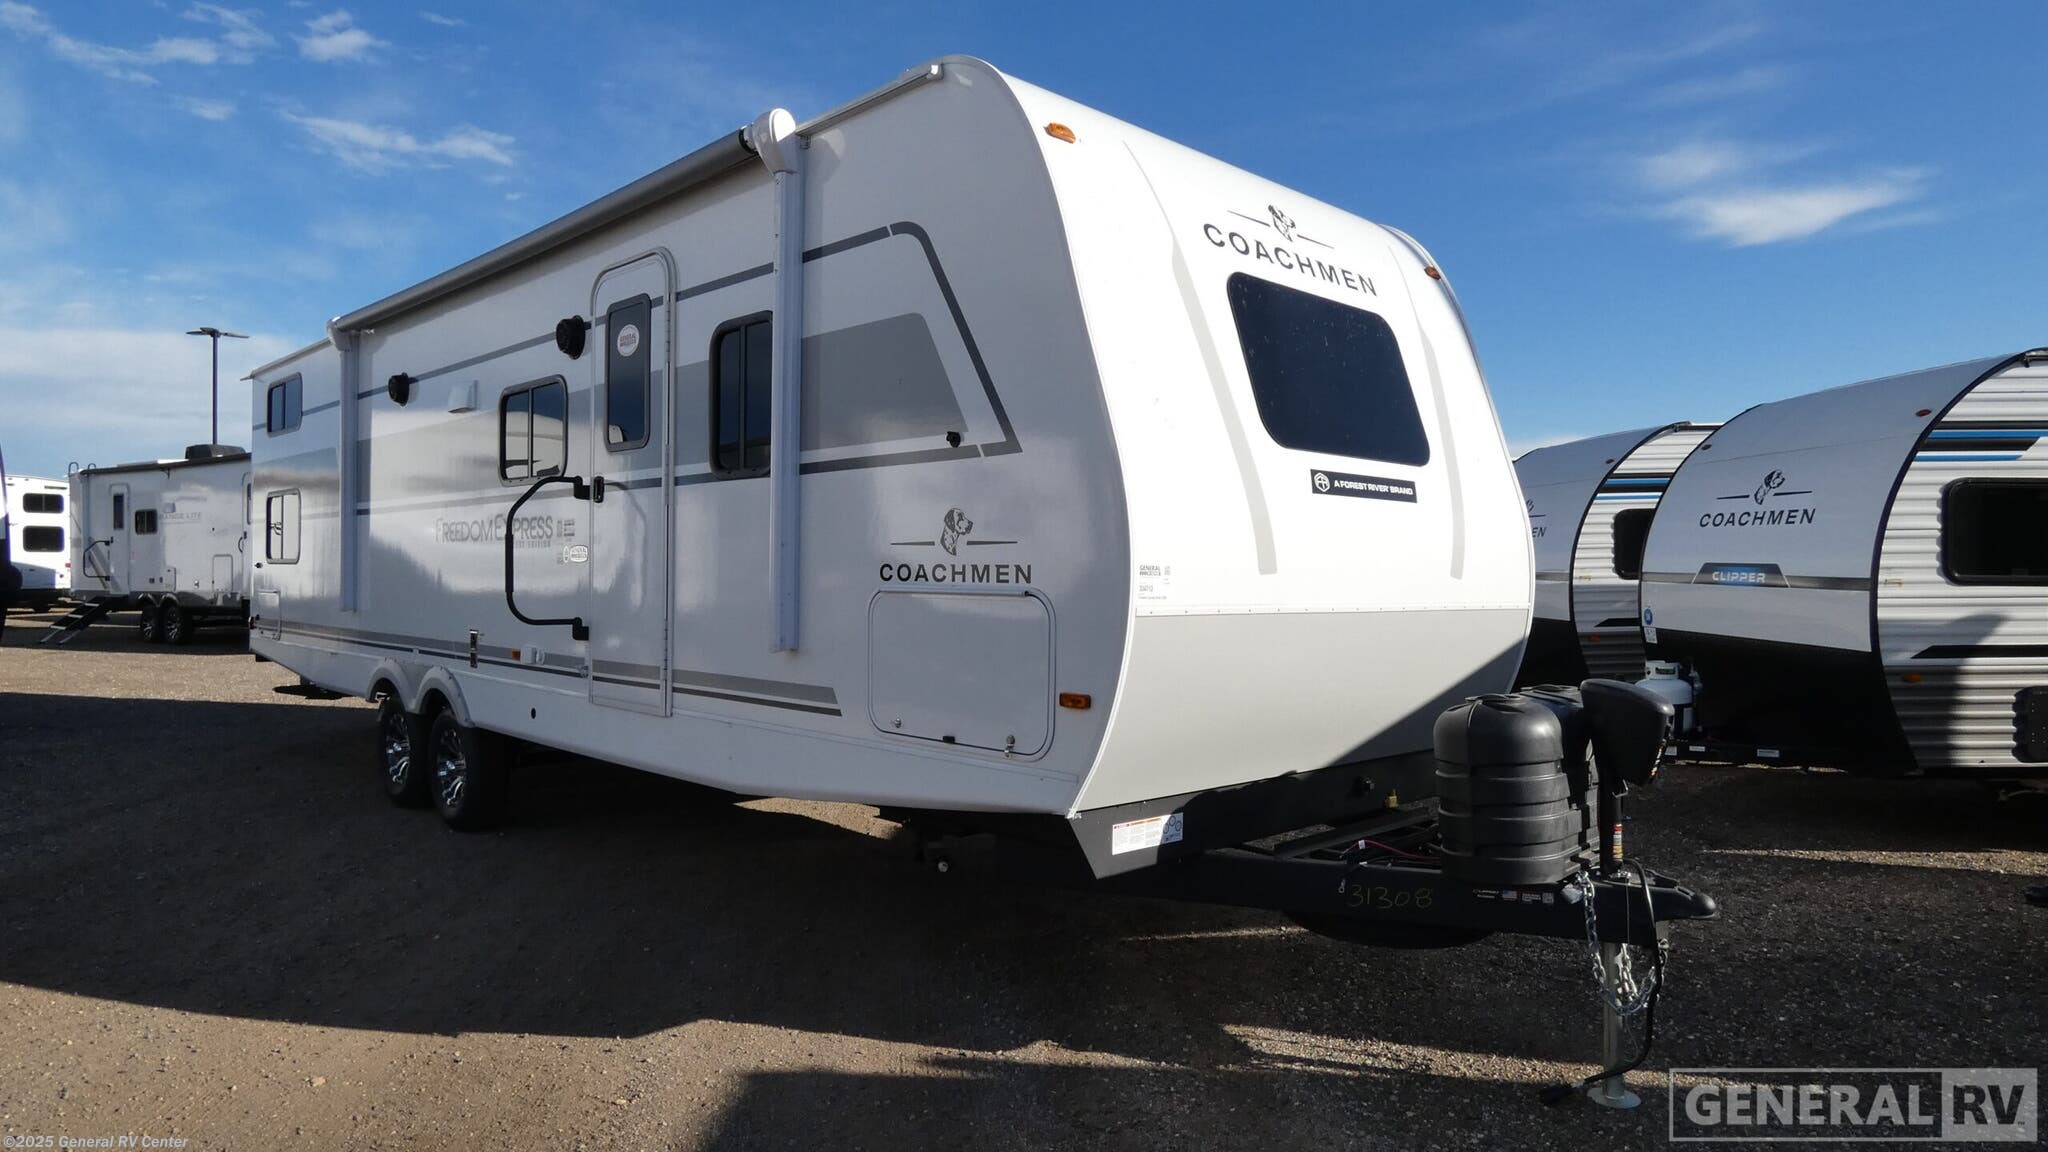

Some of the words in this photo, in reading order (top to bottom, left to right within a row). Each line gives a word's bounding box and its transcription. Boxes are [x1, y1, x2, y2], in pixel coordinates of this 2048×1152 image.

[1203, 223, 1377, 297] COACHMEN
[1340, 480, 1368, 491] FOREST
[1368, 482, 1389, 493] RIVER
[1390, 485, 1414, 496] BRAND
[1699, 508, 1816, 528] COACHMEN
[879, 563, 1032, 584] COACHMEN
[1712, 571, 1766, 583] CLIPPER
[1346, 884, 1433, 909] 31308
